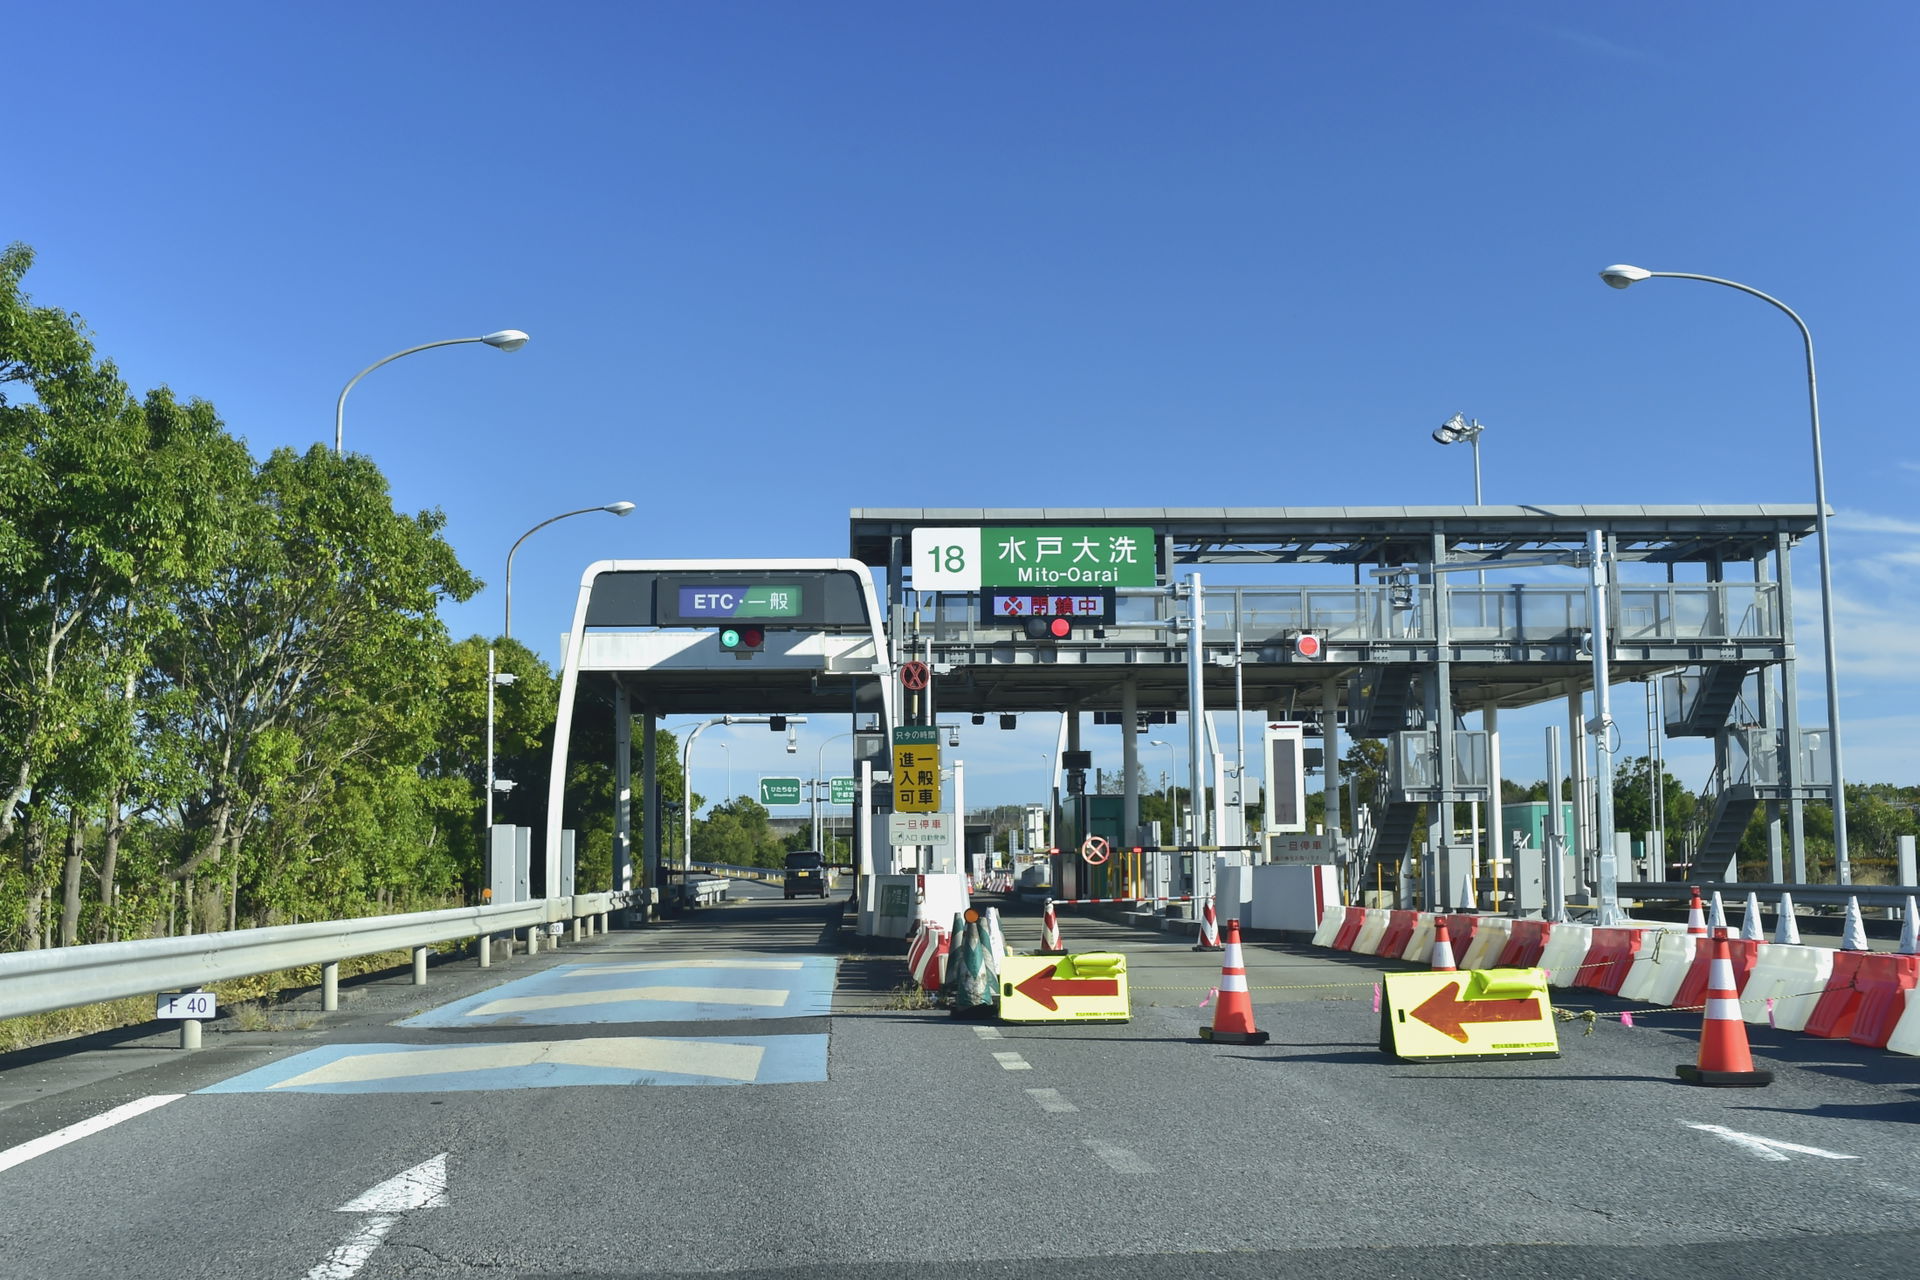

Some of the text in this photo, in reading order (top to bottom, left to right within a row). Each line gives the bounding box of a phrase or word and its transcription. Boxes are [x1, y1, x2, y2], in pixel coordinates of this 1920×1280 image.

[998, 536, 1137, 564] 水戸大洗
[928, 545, 965, 573] 18
[1018, 567, 1119, 582] Mito-Oarai
[1031, 596, 1097, 616] 閉鎖中
[896, 730, 936, 740] 只今の時間
[895, 819, 942, 830] 一旦停車
[169, 997, 207, 1014] F 40
